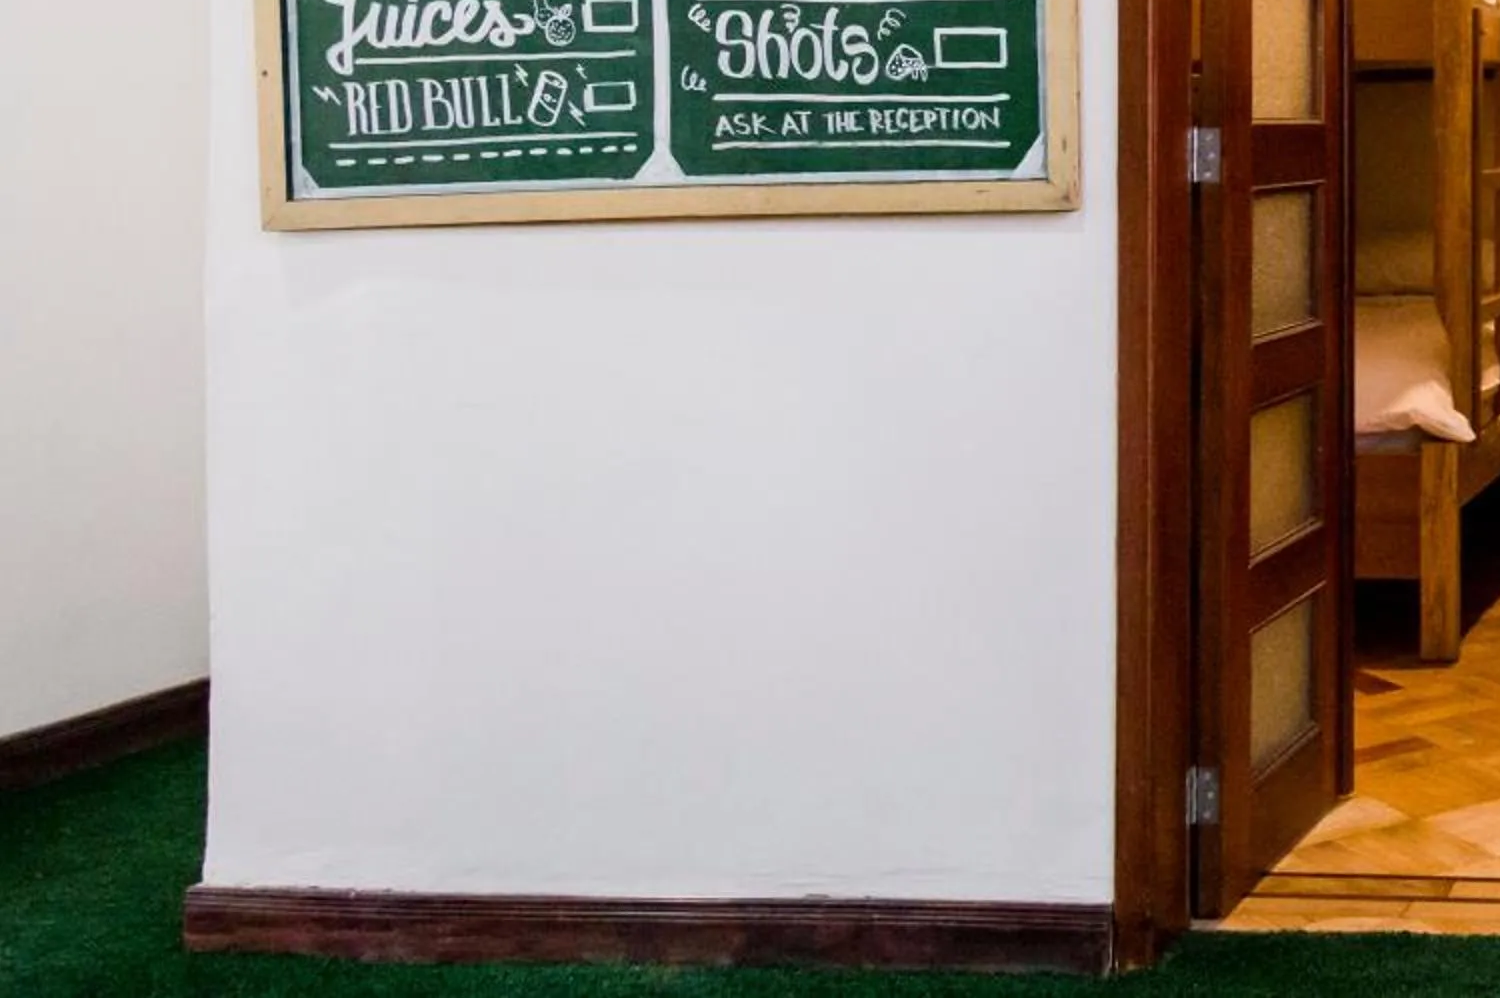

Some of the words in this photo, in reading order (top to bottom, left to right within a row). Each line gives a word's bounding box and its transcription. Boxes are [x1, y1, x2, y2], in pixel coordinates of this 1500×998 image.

[716, 7, 879, 85] Shots
[346, 78, 413, 136] RED
[417, 73, 523, 132] BULL
[715, 115, 777, 137] ASK
[781, 111, 813, 134] AT
[822, 112, 864, 134] THE
[867, 107, 1001, 134] RECEPTION
